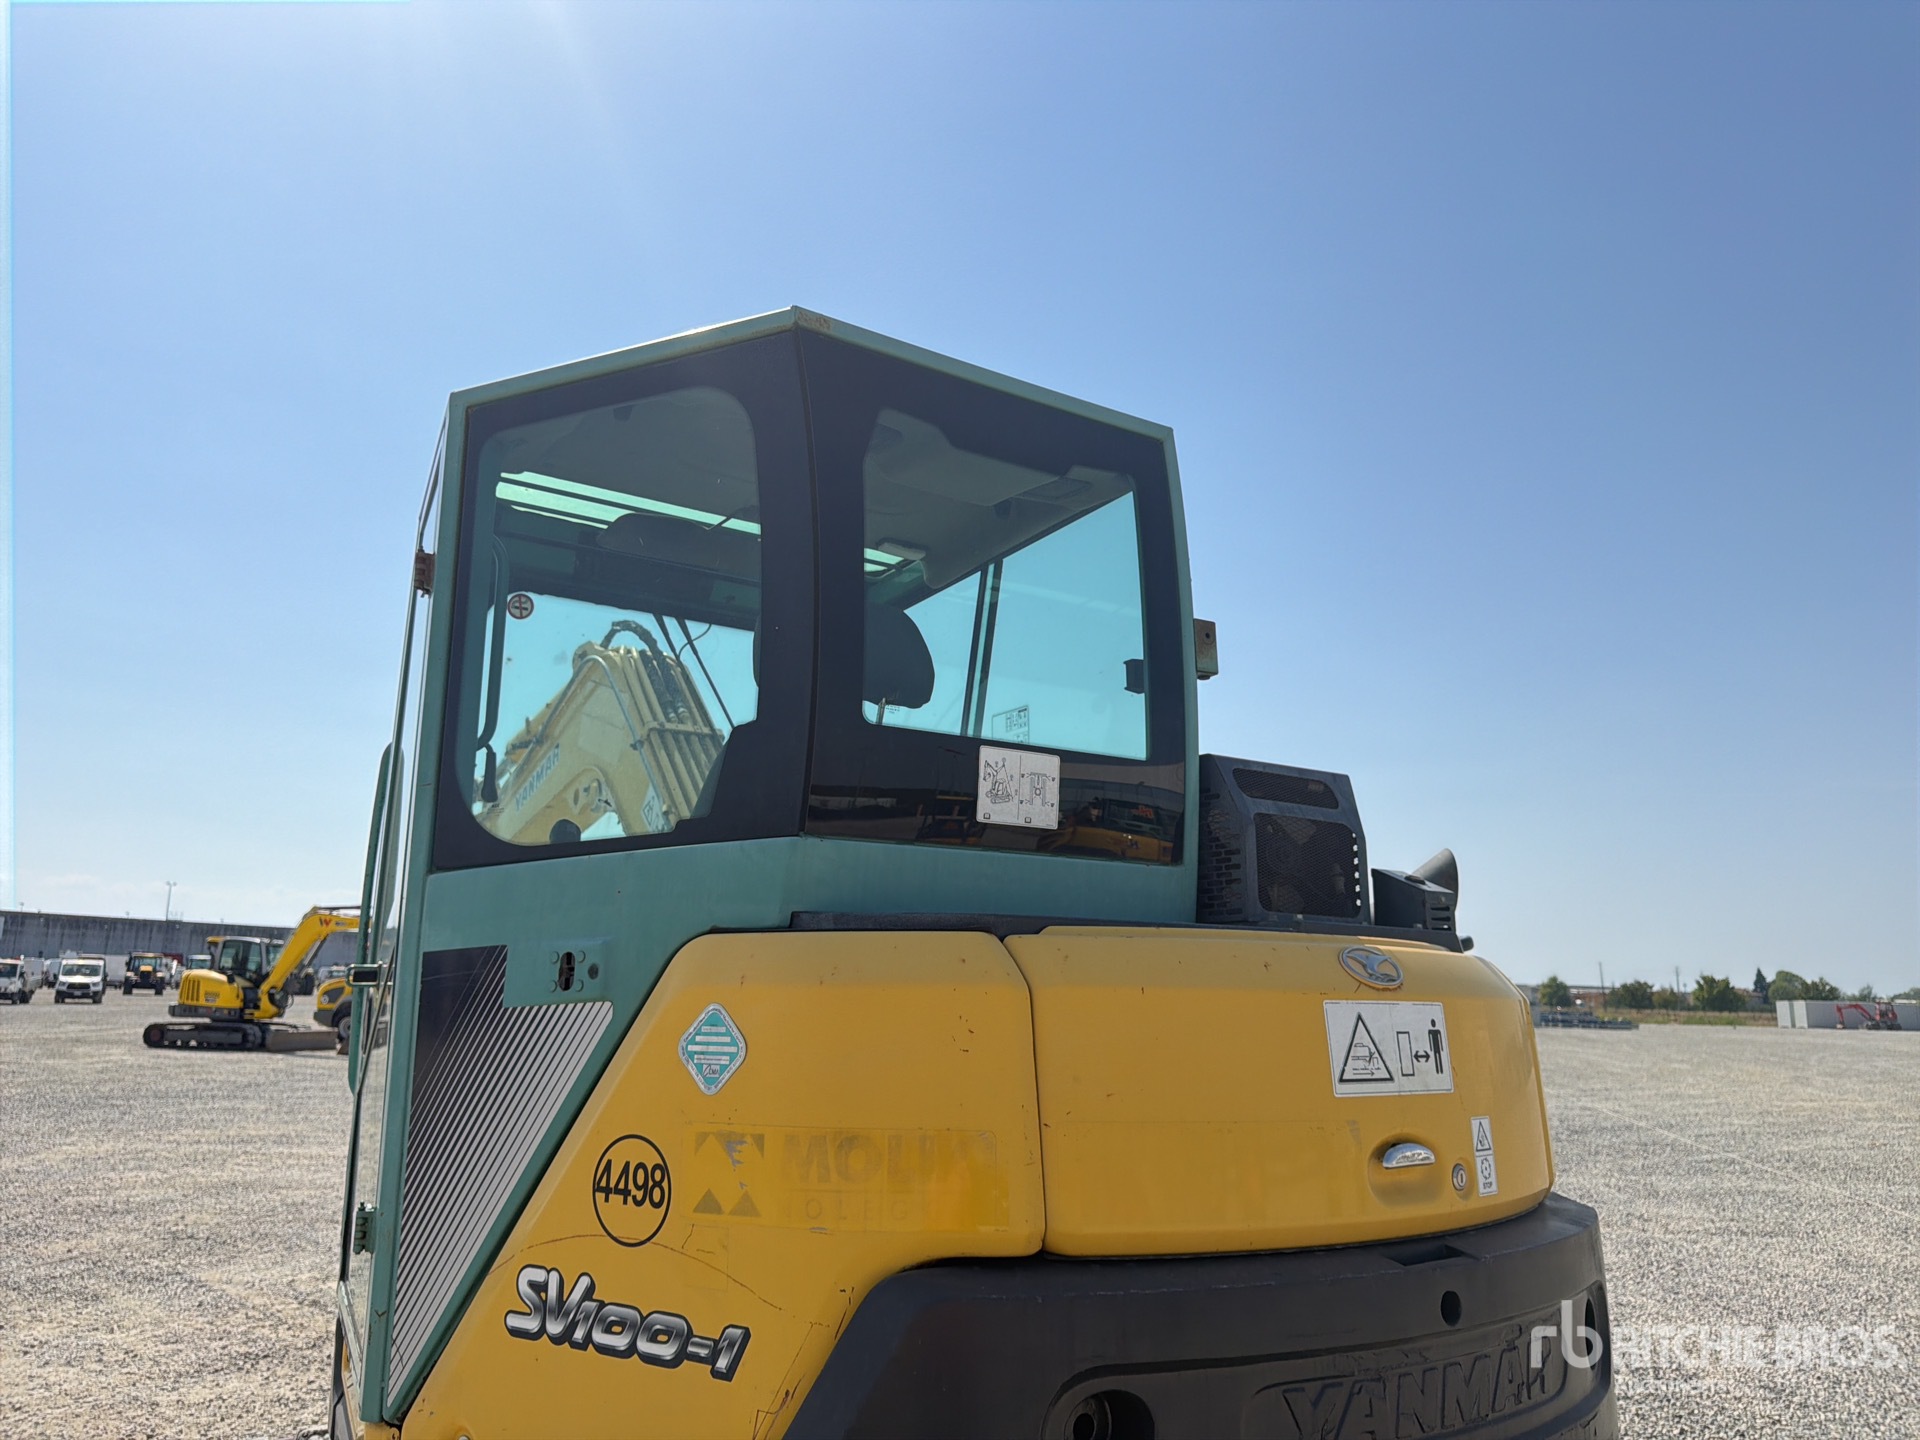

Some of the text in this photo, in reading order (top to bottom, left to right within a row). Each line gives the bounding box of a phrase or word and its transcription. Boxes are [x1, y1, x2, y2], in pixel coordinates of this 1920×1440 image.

[595, 1158, 666, 1210] 4498
[1482, 1180, 1493, 1190] STOP
[504, 1264, 751, 1383] SV100-1
[1281, 1335, 1552, 1440] YANMAR
